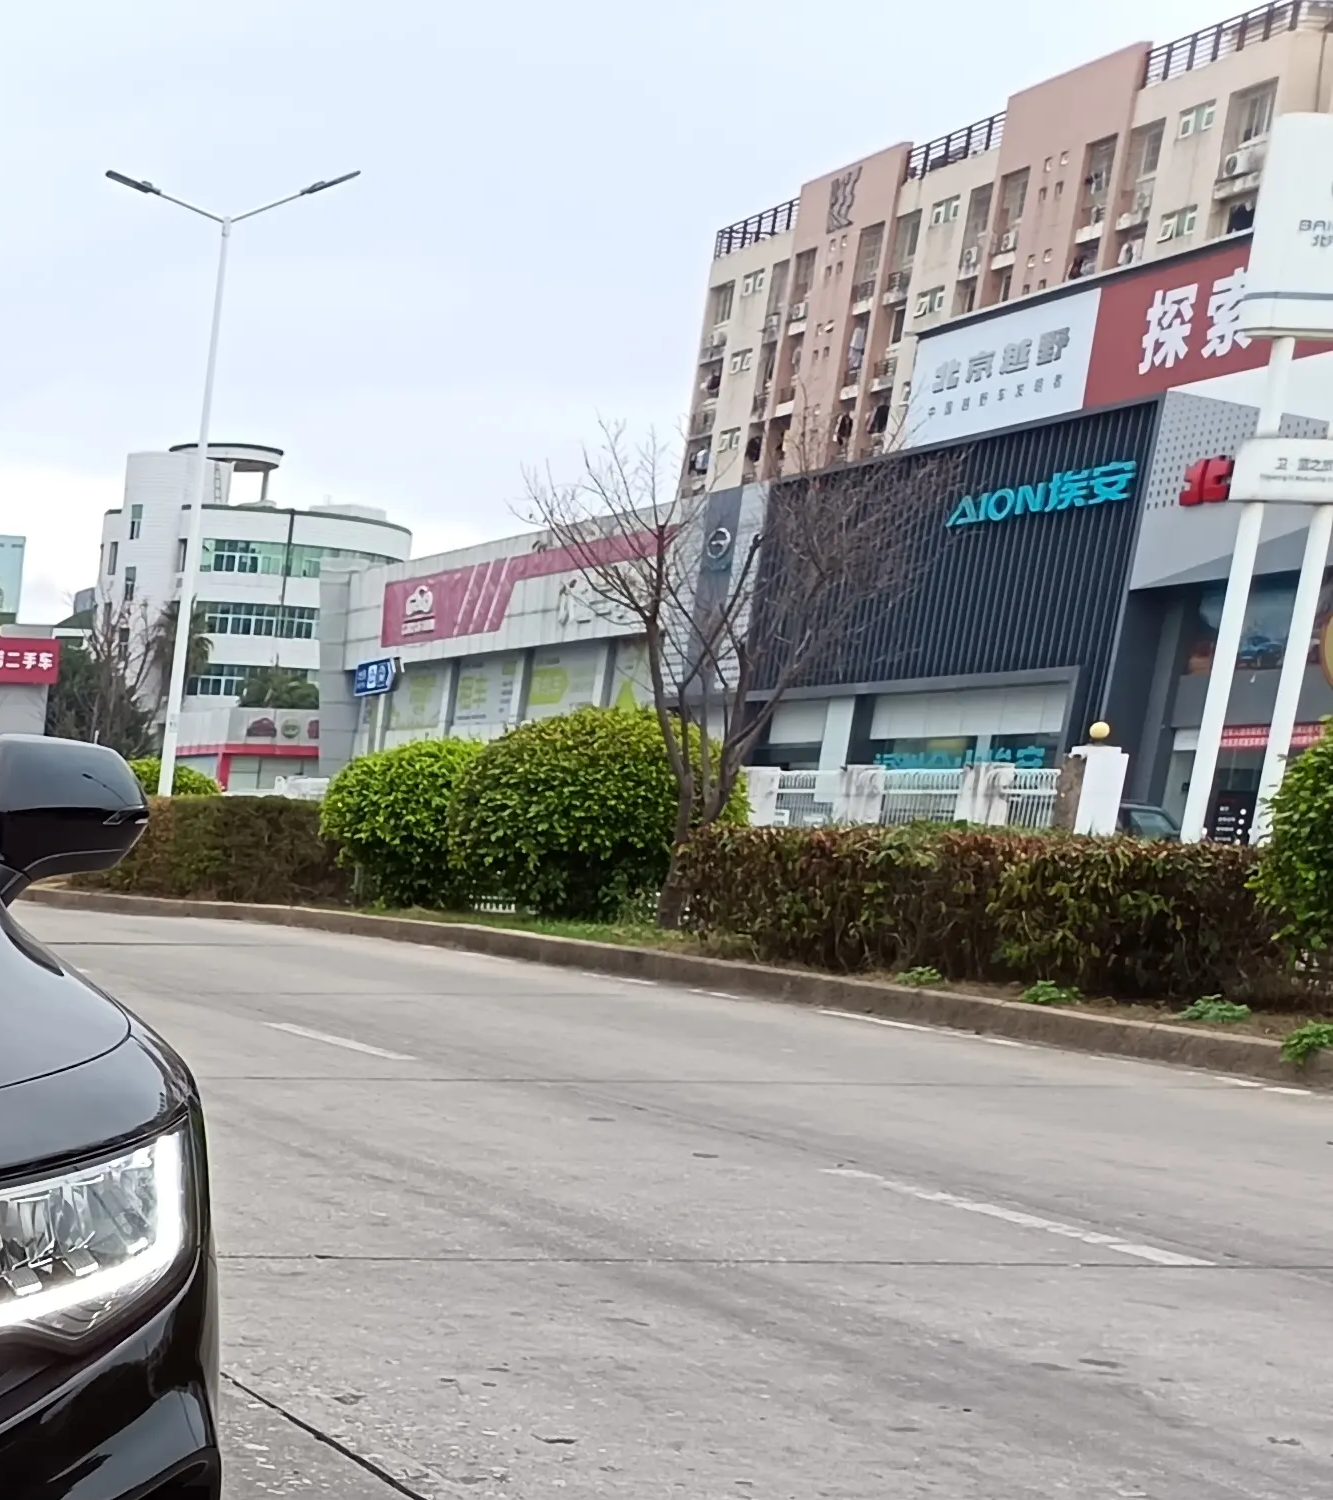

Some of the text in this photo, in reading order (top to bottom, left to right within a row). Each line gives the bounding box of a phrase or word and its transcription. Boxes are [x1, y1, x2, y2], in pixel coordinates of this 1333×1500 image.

[1299, 219, 1333, 231] BAI
[1138, 266, 1253, 376] 探索
[932, 326, 1071, 394] 北京越野
